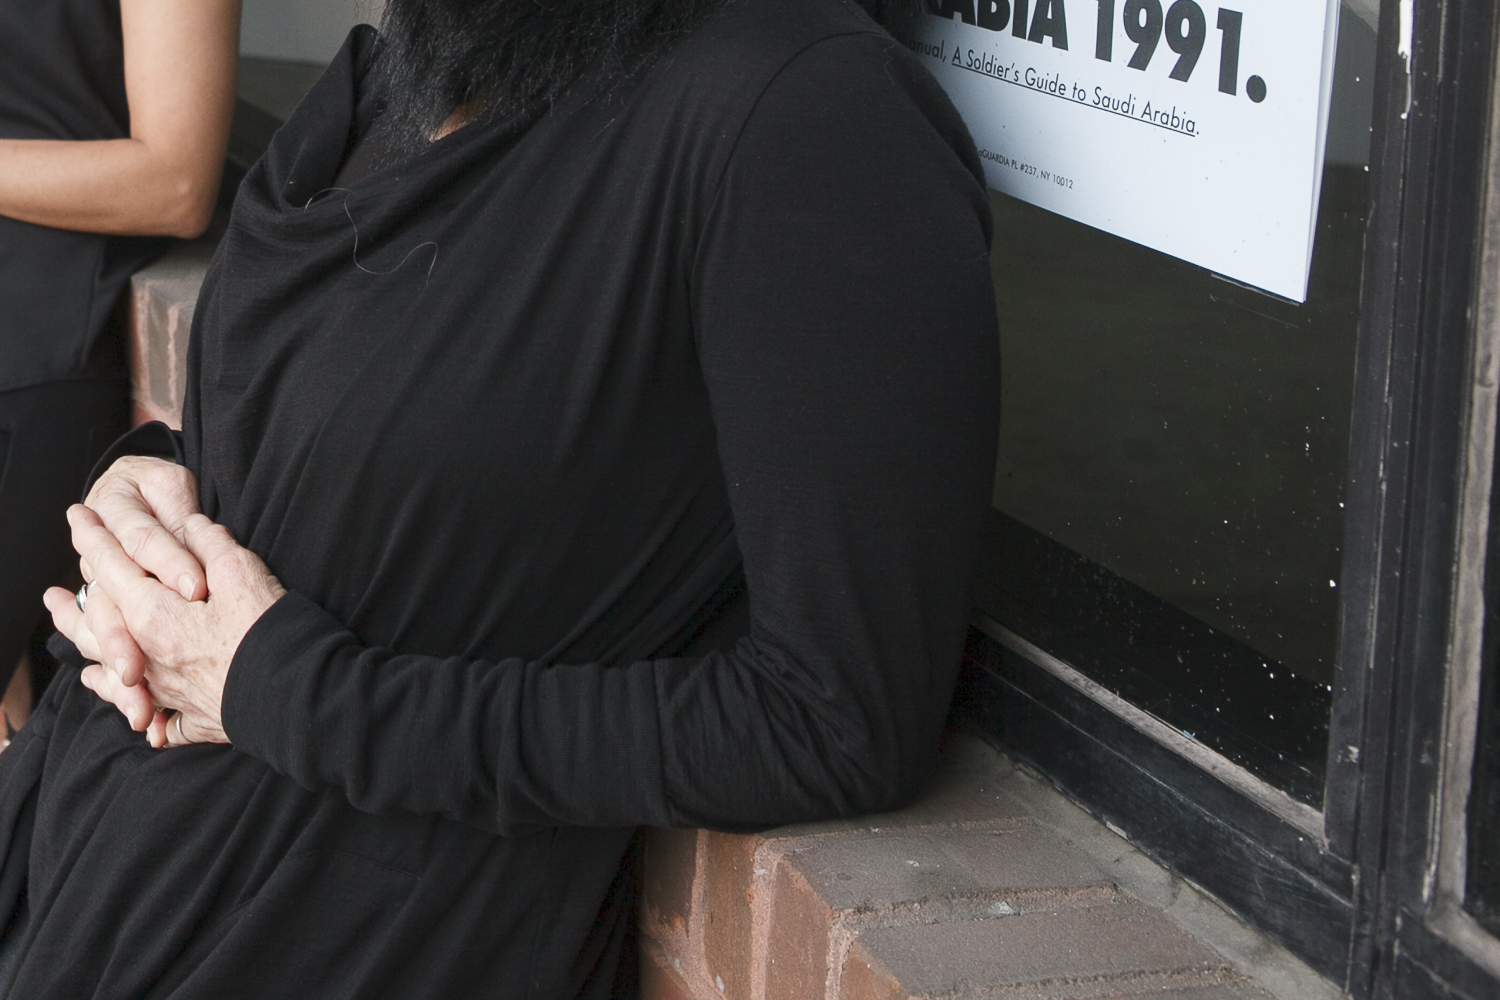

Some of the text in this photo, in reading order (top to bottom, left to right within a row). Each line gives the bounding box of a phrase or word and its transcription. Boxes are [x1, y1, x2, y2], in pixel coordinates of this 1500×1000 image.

[905, 39, 1200, 135] anual, A Soldier's Guide to Saudi Arabia.
[1011, 159, 1019, 170] PL
[1020, 163, 1040, 179] #237,
[1040, 169, 1051, 181] NY
[1052, 173, 1074, 190] 10012
